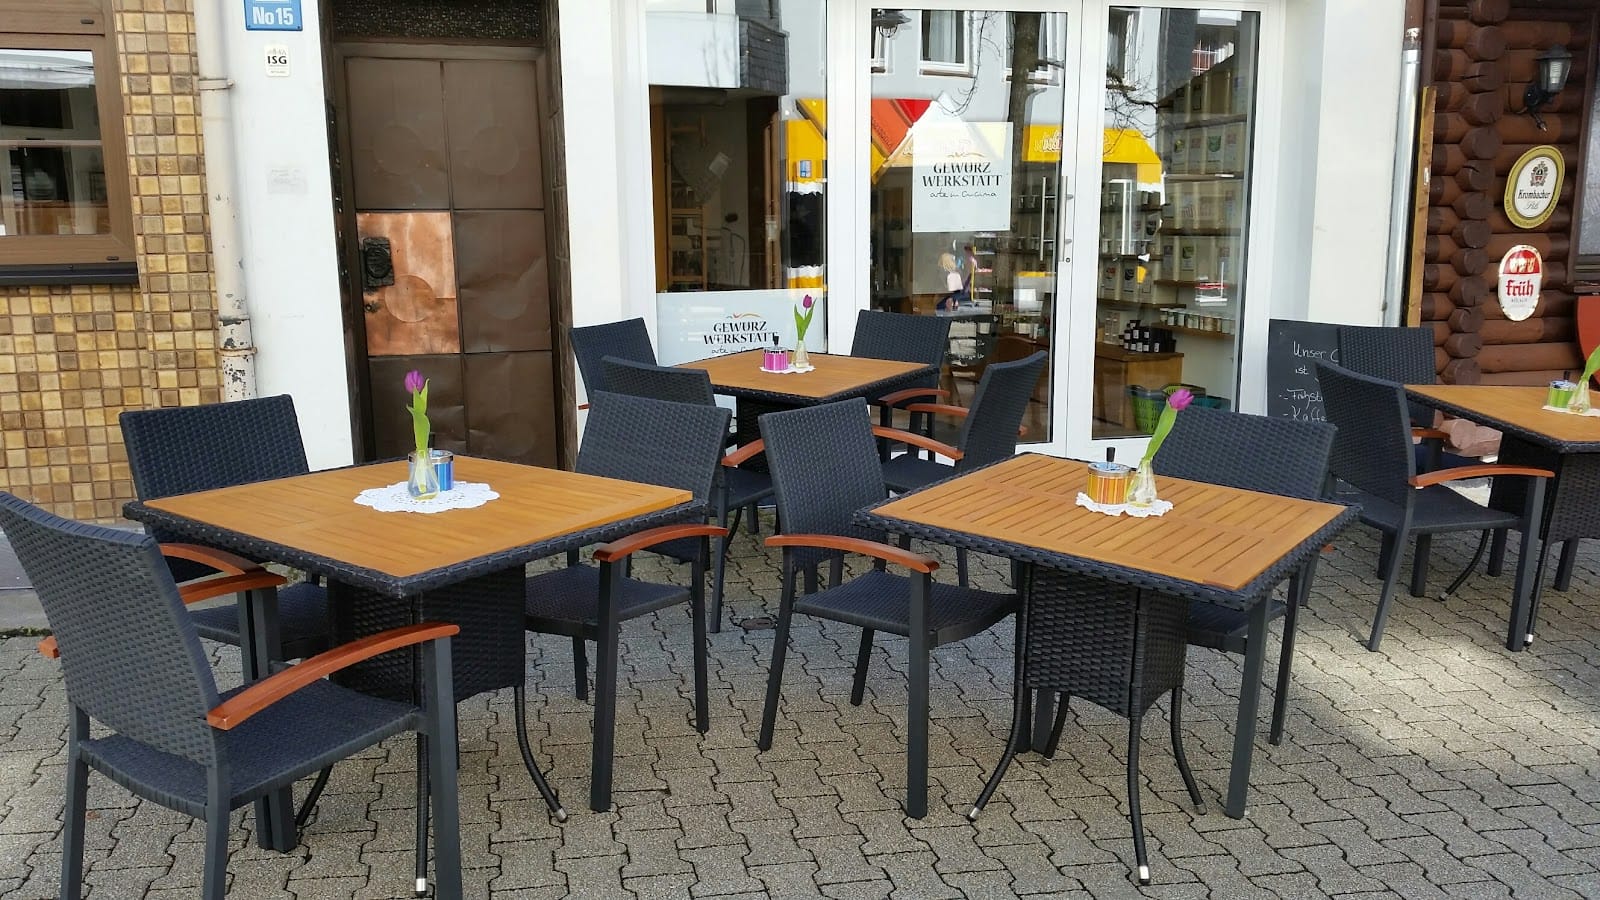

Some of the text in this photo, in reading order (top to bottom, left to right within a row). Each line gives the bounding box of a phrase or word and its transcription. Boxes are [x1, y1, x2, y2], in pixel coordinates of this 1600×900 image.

[267, 55, 287, 64] ISG
[922, 175, 1002, 187] WERKSTATT
[1506, 279, 1534, 297] früh
[703, 332, 778, 345] WERKSTATT
[1293, 340, 1327, 359] Unser
